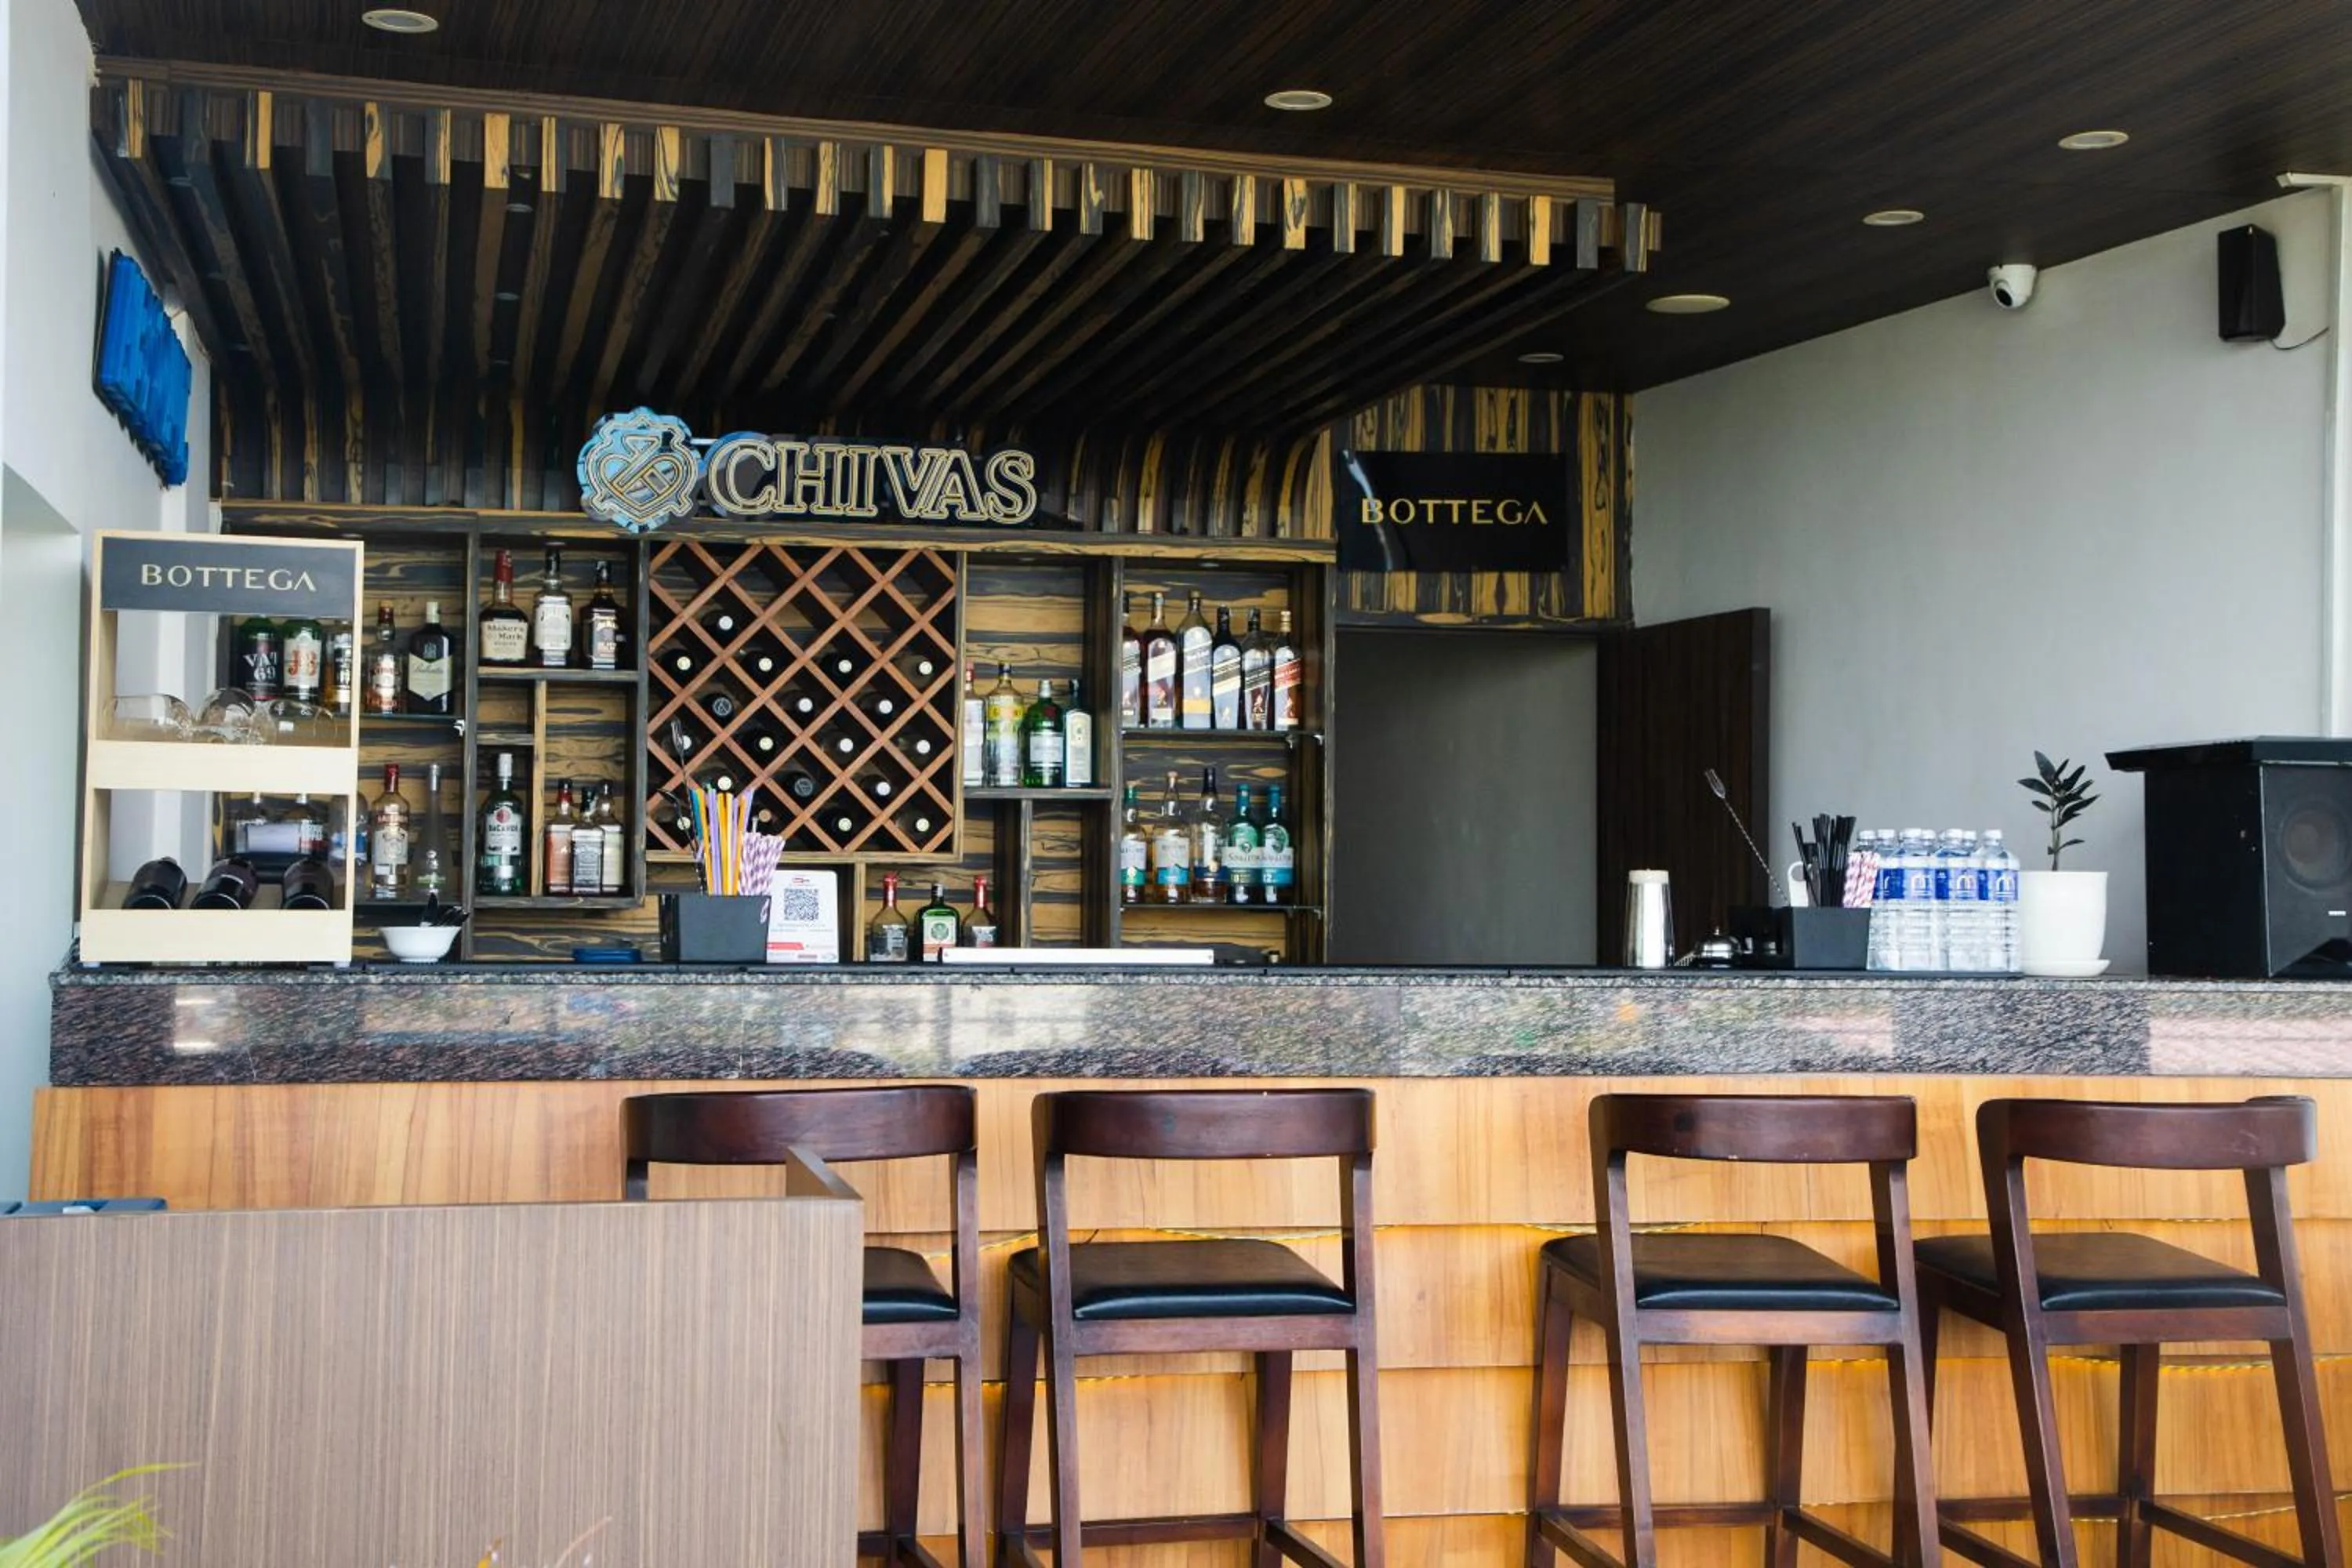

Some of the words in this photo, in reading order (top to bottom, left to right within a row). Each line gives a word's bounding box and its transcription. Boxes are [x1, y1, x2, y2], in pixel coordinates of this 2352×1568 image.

[708, 438, 1036, 524] CHIVAS
[1362, 498, 1548, 524] BOTTEGA
[141, 564, 317, 592] BOTTEGA
